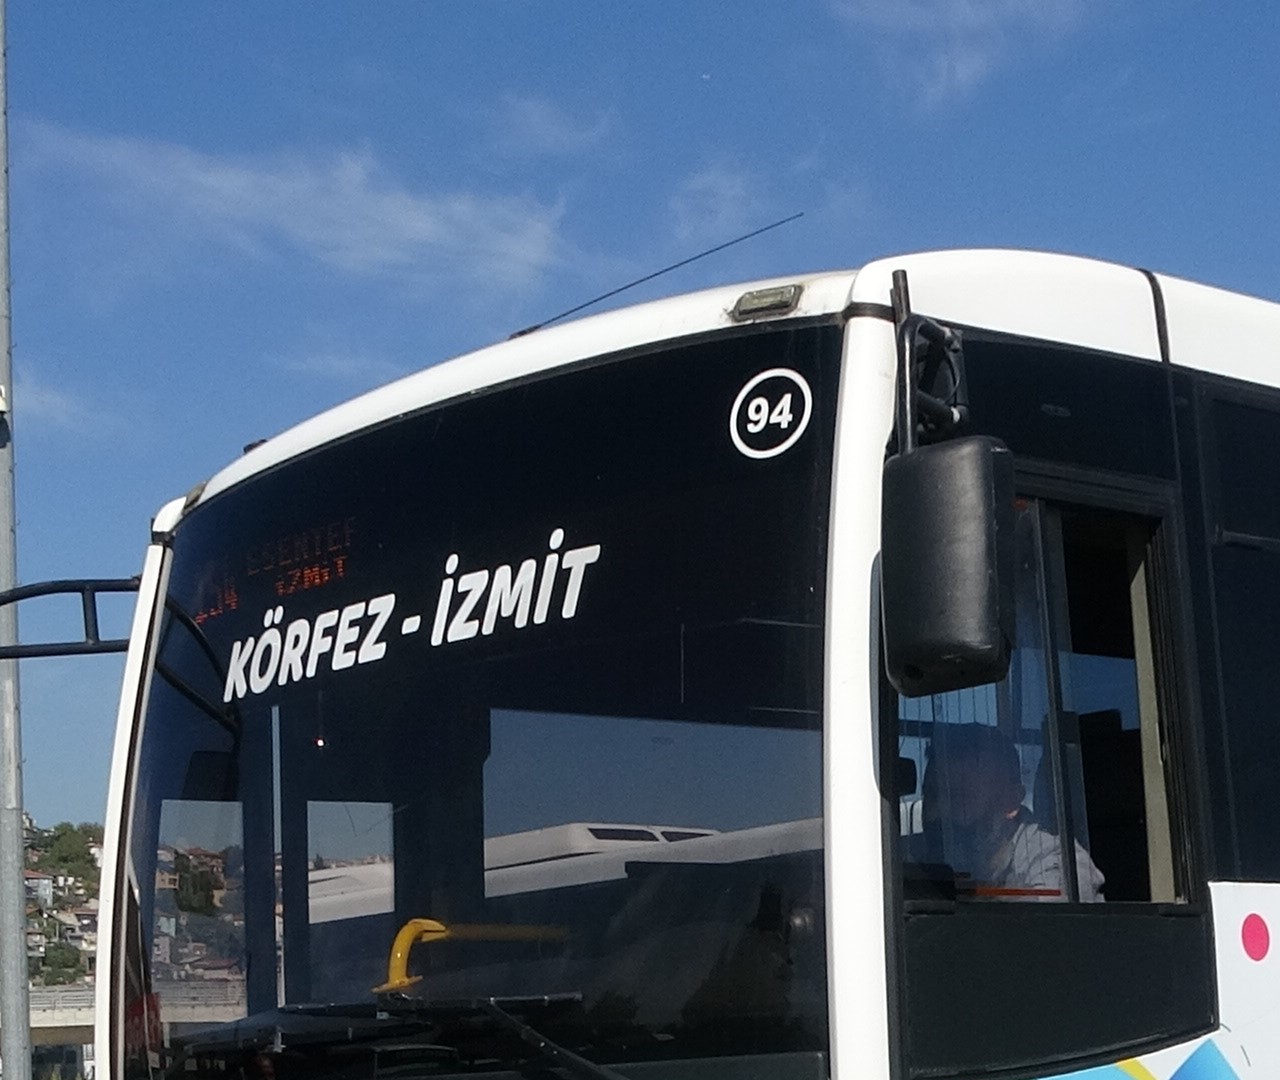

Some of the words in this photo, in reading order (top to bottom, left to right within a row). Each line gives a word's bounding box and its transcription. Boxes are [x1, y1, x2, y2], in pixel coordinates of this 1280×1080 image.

[746, 393, 794, 434] 94
[222, 593, 397, 701] KÖRFEZ
[430, 528, 601, 646] İZMİT
